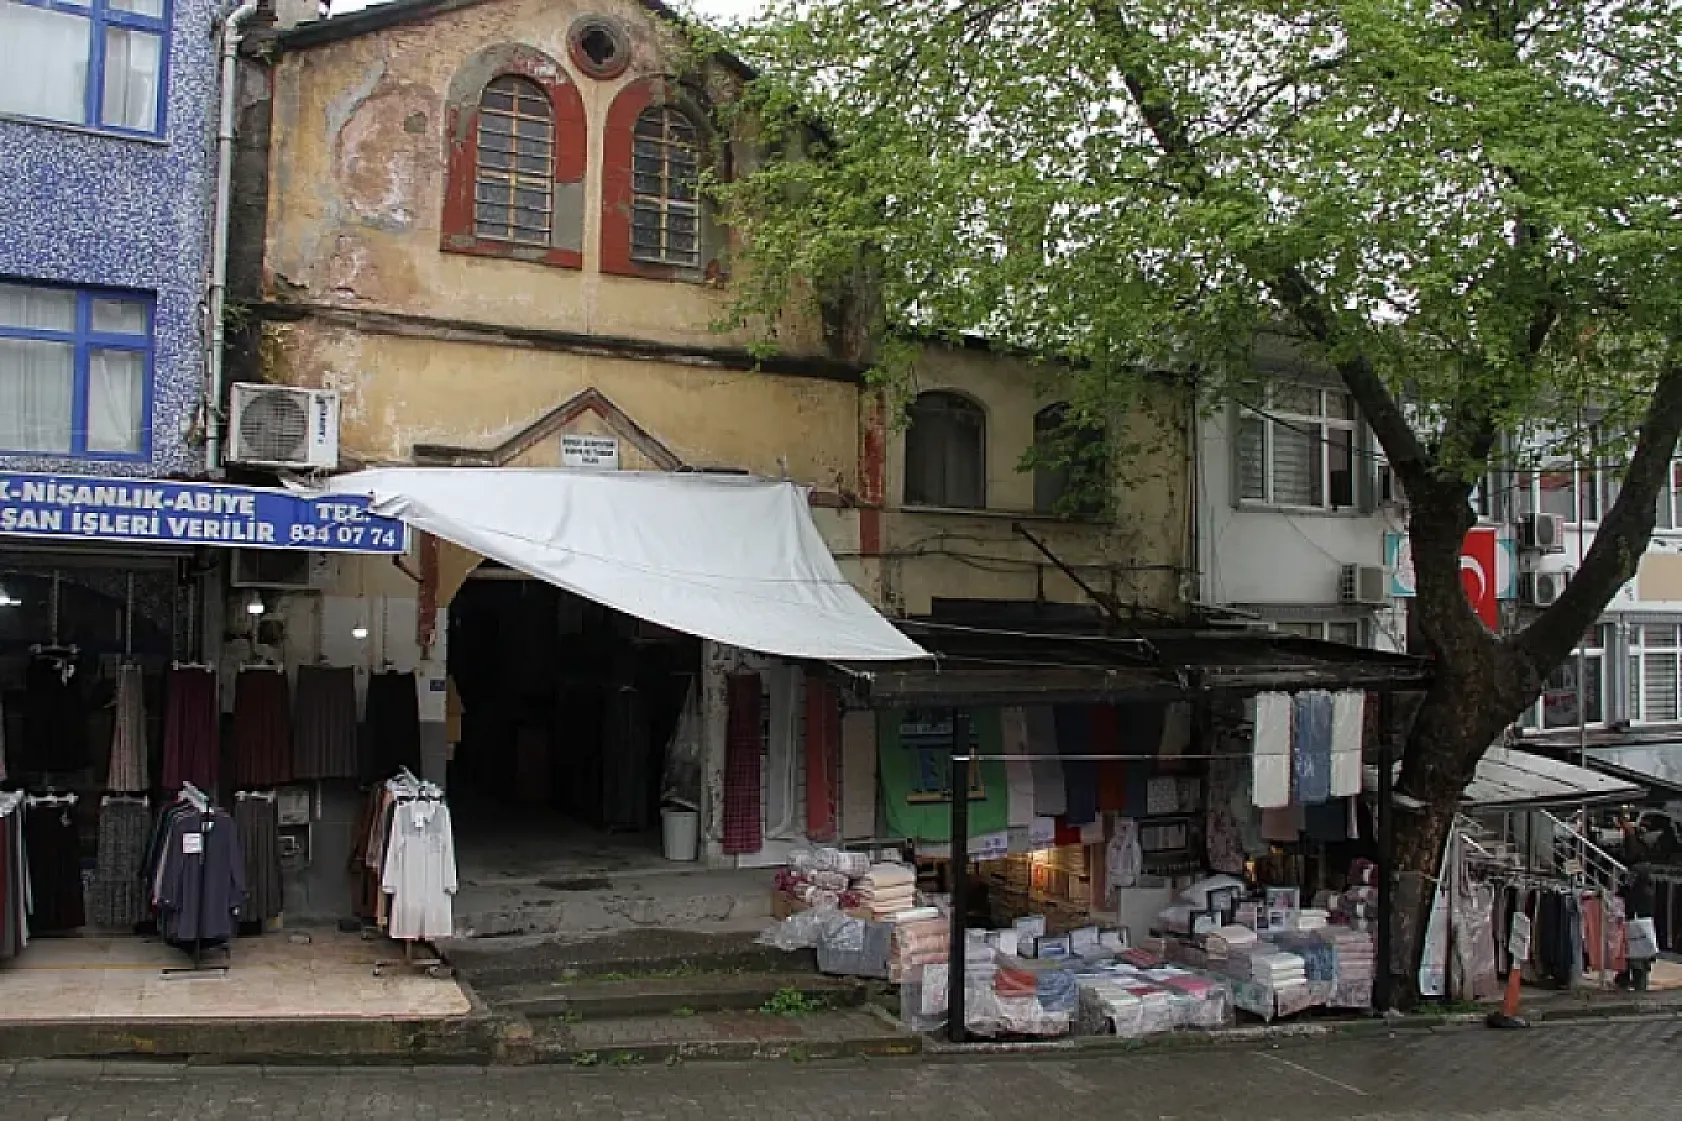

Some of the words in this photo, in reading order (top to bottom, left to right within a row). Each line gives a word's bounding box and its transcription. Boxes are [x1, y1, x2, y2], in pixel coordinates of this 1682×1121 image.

[72, 506, 159, 535] İŞLERİ
[168, 515, 275, 541] VERİLİR
[337, 527, 365, 544] 07
[371, 528, 394, 546] 74
